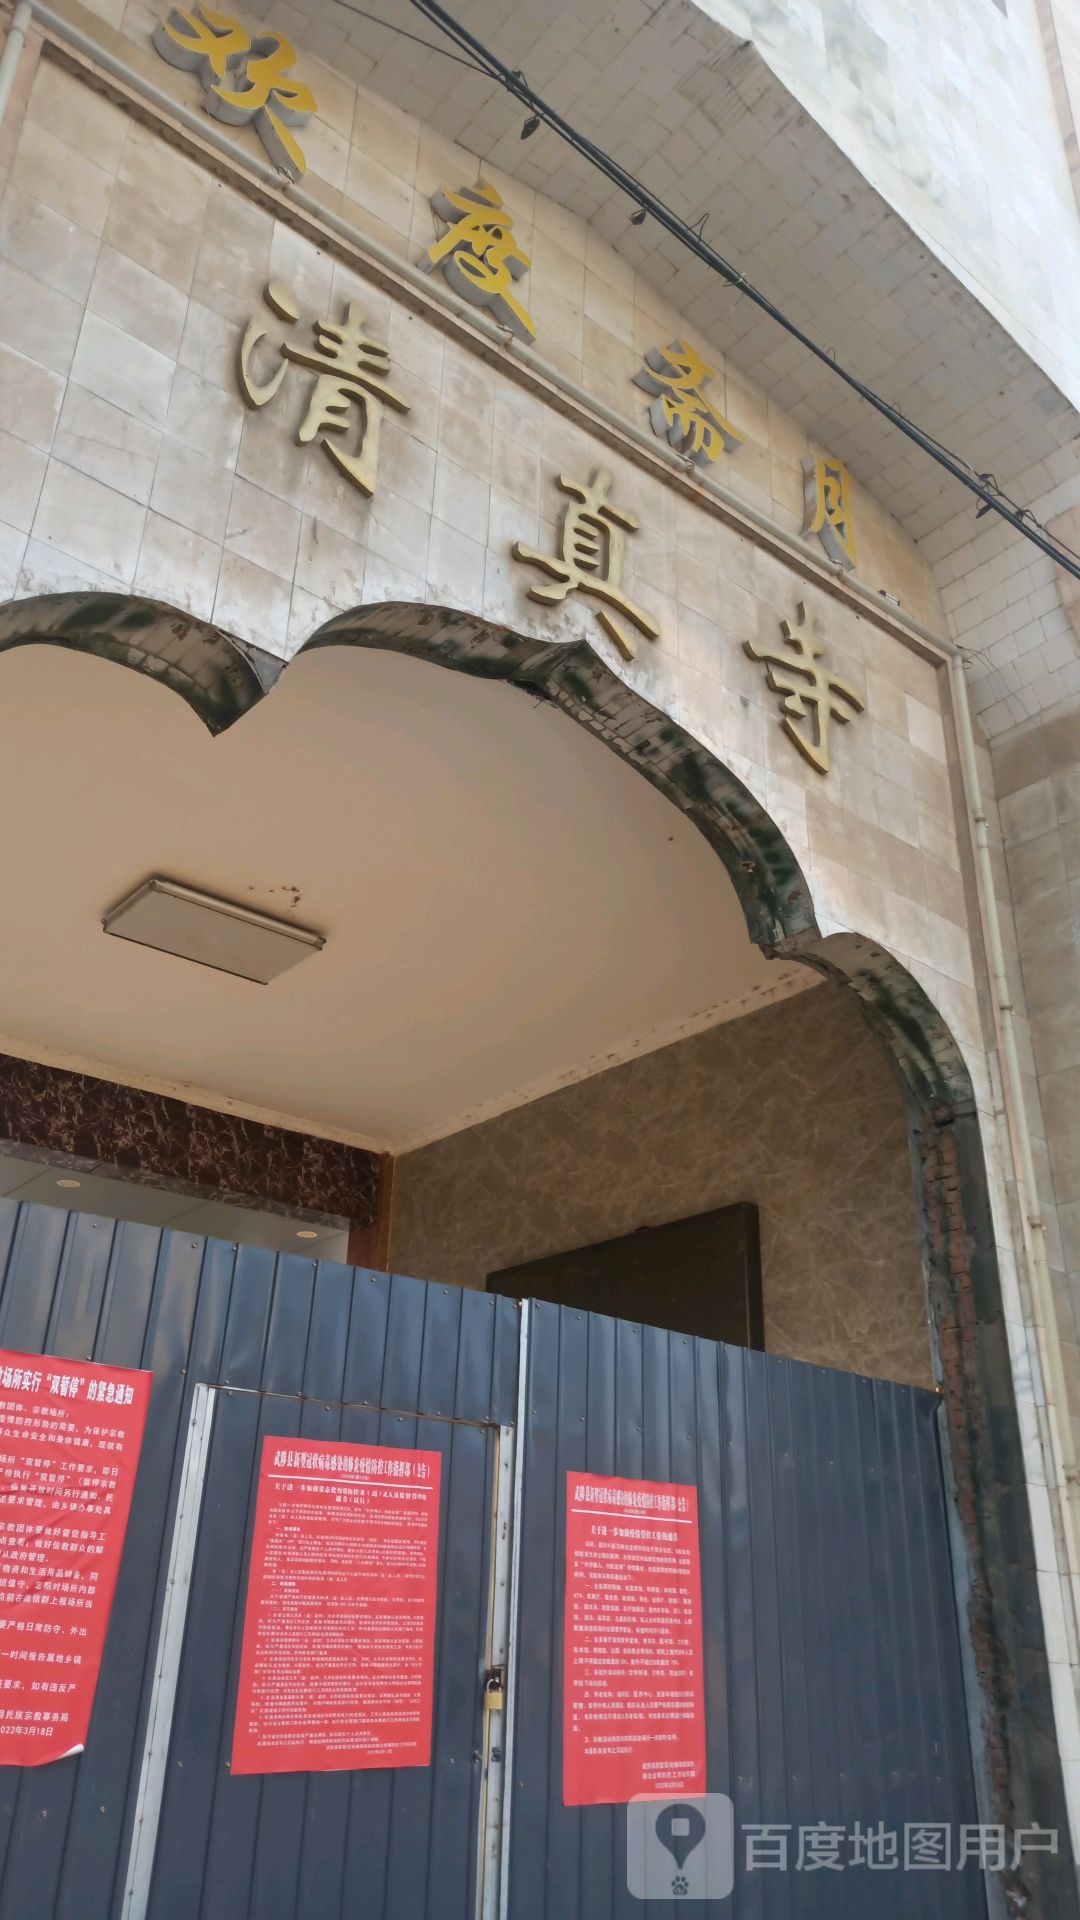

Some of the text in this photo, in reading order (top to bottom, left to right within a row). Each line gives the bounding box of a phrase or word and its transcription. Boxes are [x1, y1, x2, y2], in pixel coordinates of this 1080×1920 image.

[236, 280, 865, 774] 清真寺
[0, 1427, 123, 1451] 众生命安全和身体健康，现就有
[0, 1550, 49, 1563] 从政府管理。
[0, 1679, 77, 1693] 要求，如有违反严
